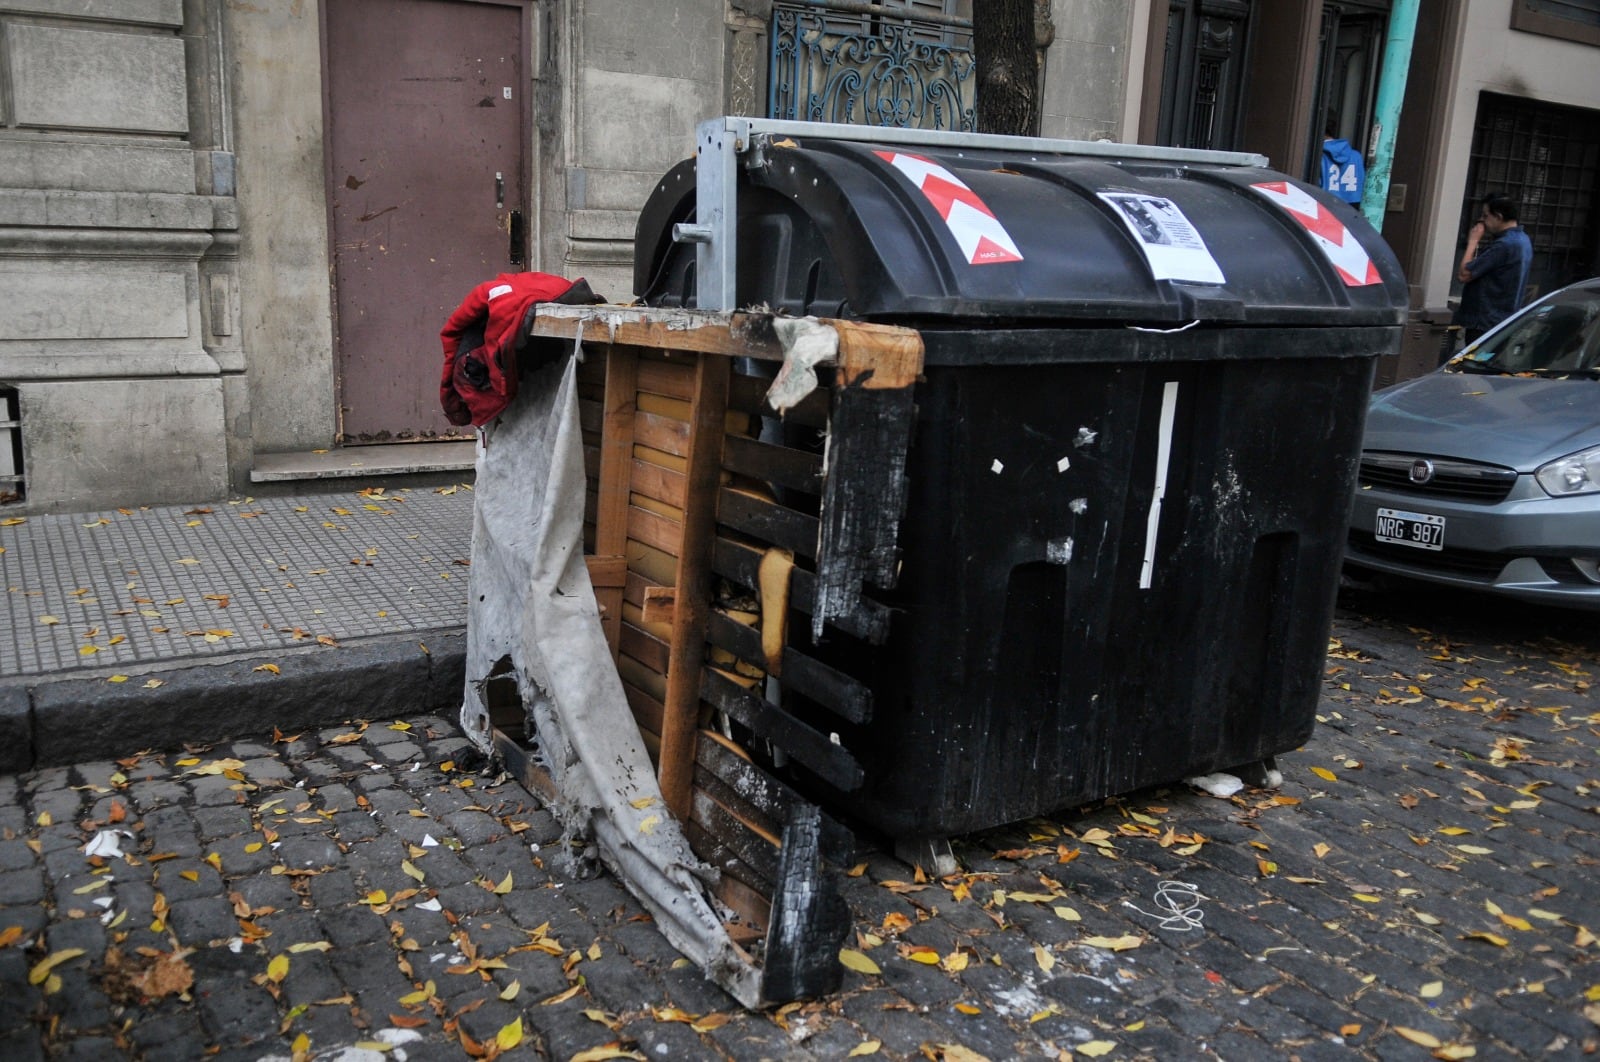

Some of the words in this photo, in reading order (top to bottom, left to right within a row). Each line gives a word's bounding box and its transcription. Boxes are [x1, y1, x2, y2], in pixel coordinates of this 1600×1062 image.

[1328, 164, 1357, 192] 24
[1378, 517, 1405, 538] NRG
[1412, 523, 1441, 544] 987
